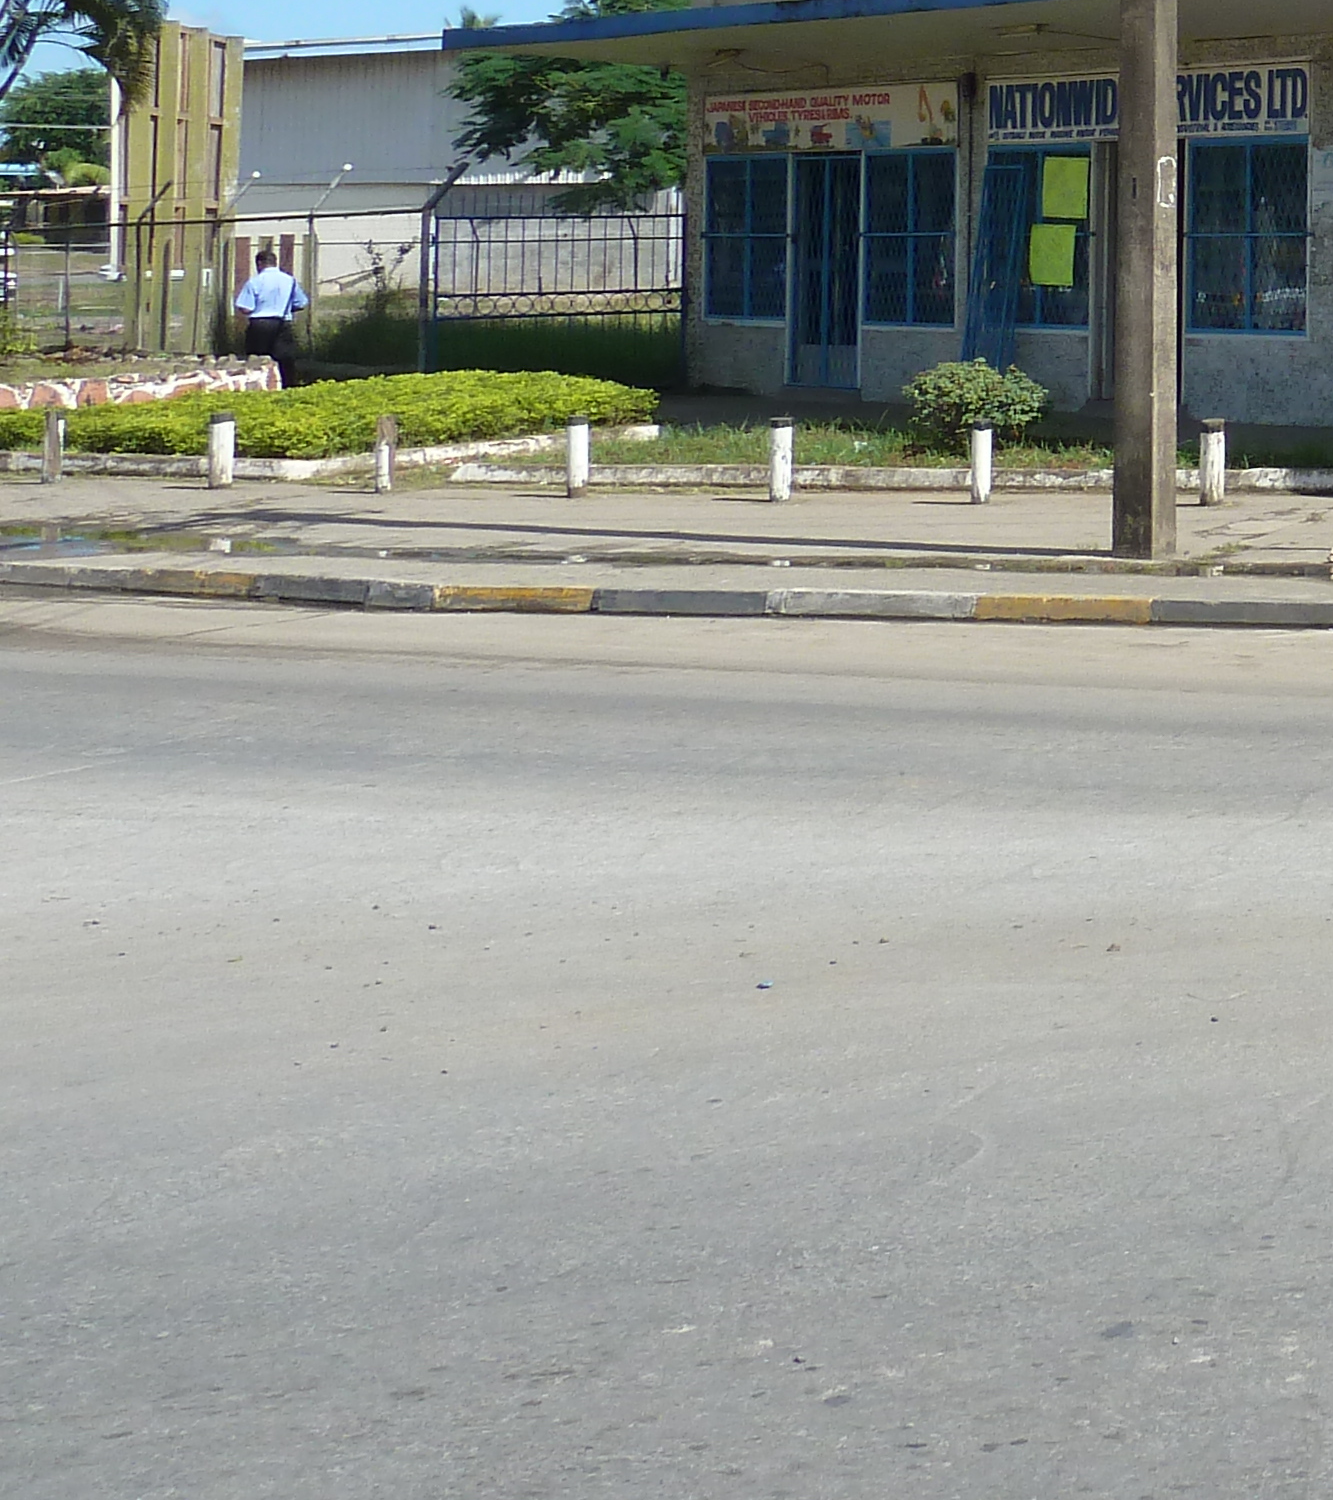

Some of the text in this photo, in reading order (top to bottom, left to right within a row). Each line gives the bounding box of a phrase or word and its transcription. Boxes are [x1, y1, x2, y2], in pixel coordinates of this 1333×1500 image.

[853, 92, 890, 106] MOTOR
[989, 78, 1118, 130] NATIONWID
[1177, 70, 1262, 122] RVICES
